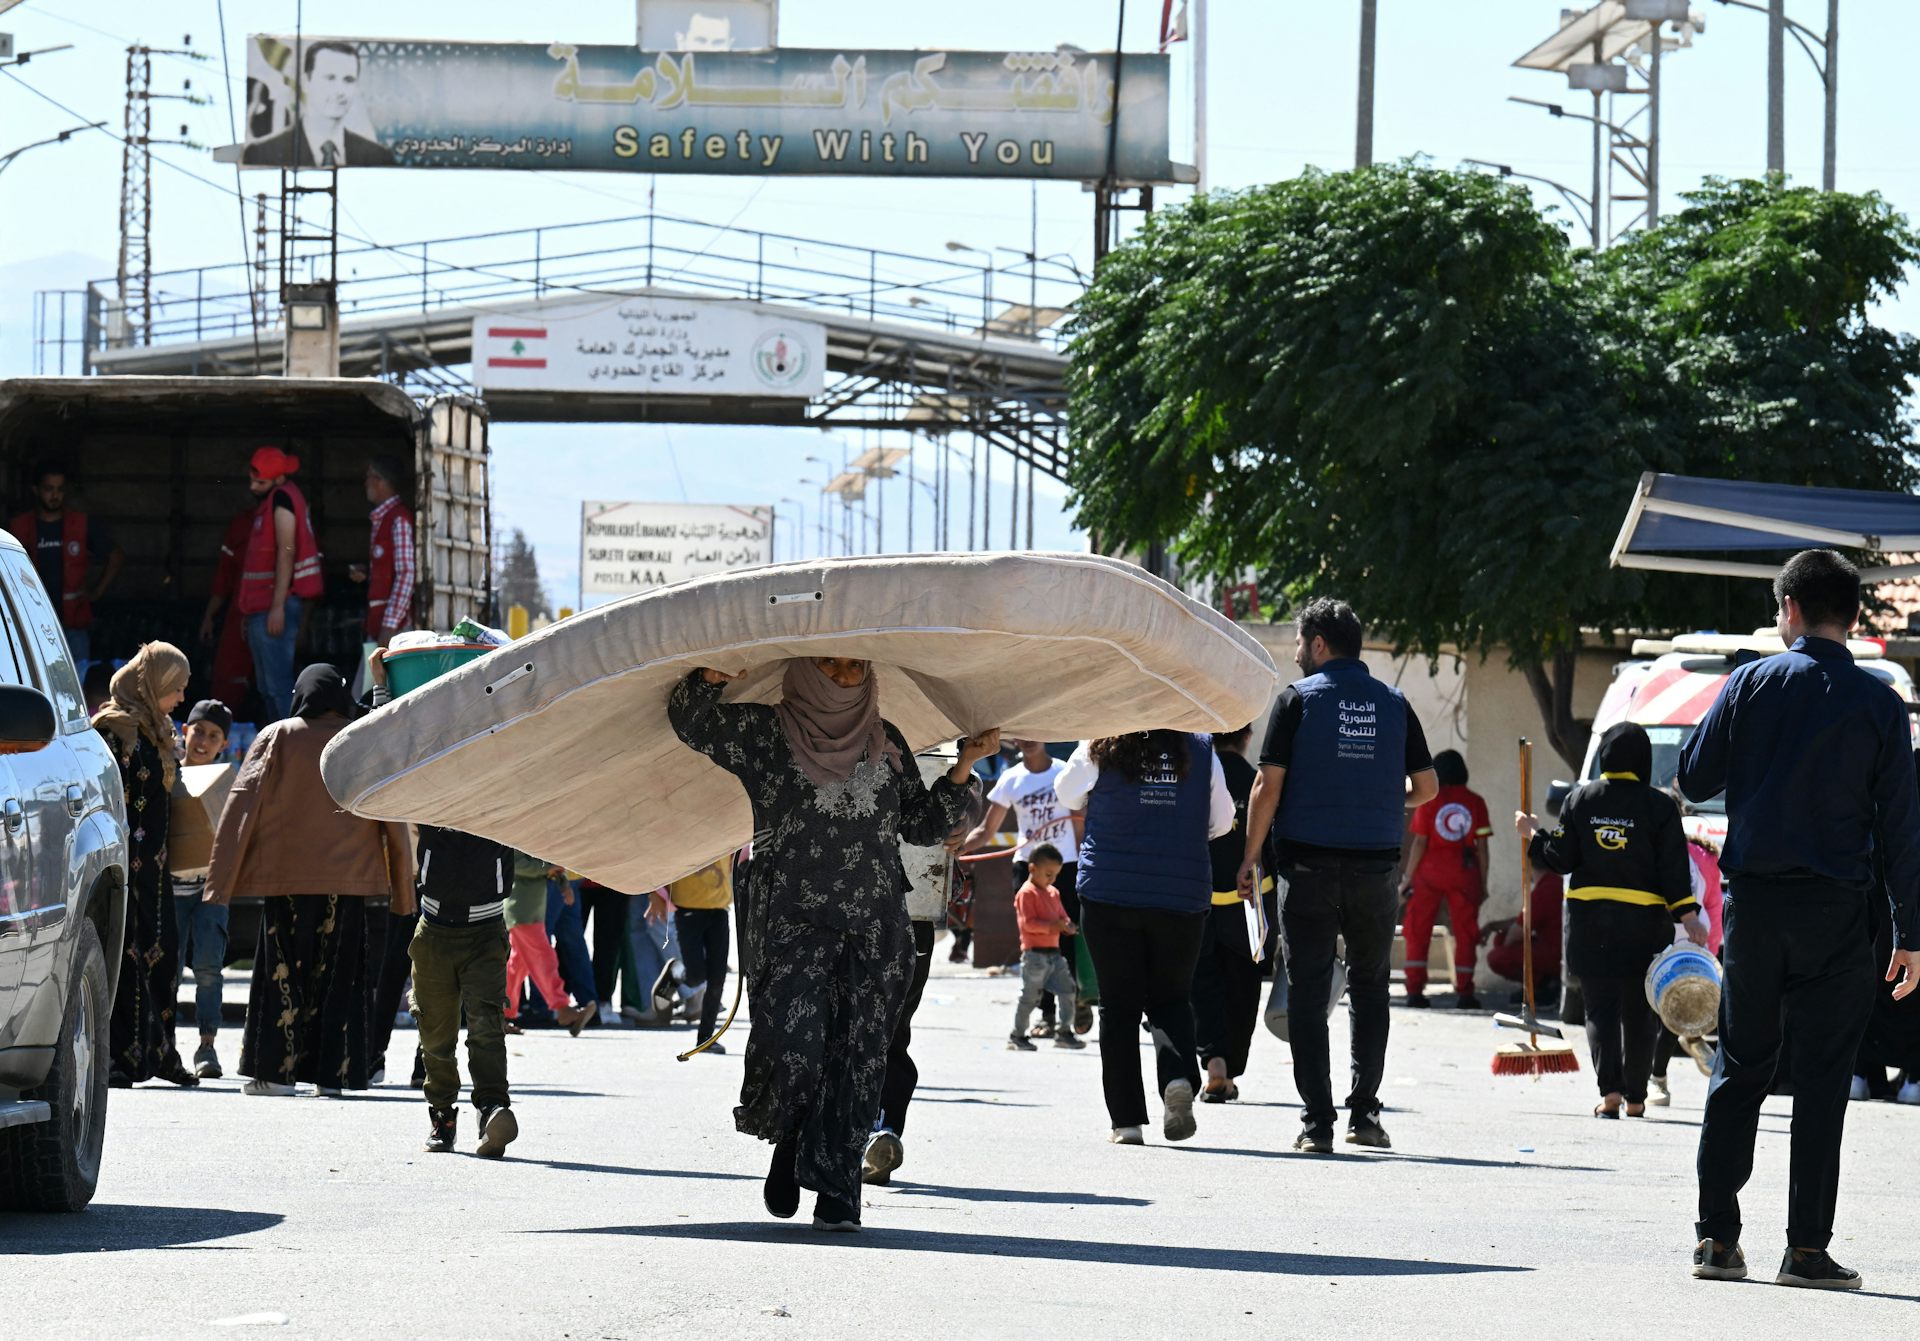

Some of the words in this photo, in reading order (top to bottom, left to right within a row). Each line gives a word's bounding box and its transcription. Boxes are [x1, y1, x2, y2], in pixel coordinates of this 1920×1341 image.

[395, 136, 465, 154] الحدودي
[467, 136, 533, 156] المركز
[535, 137, 573, 158] إدارة
[613, 124, 782, 167] Safety
[813, 128, 929, 164] With
[961, 132, 1055, 165] You
[575, 338, 617, 356] العامة
[621, 341, 678, 360] الجمارك
[683, 342, 730, 361] مديرية
[588, 361, 647, 381] الحدودي
[650, 361, 684, 383] القاع
[691, 362, 725, 382] مركز
[684, 548, 722, 565] العام
[725, 545, 761, 566] الأمن
[630, 569, 666, 585] KAA
[1338, 699, 1376, 712] الأمانة
[1338, 711, 1377, 724] السورية
[1338, 723, 1377, 737] للتنمية
[1337, 750, 1375, 760] Development
[1352, 743, 1366, 751] Trust
[1140, 797, 1177, 806] Development
[1030, 806, 1055, 823] THE
